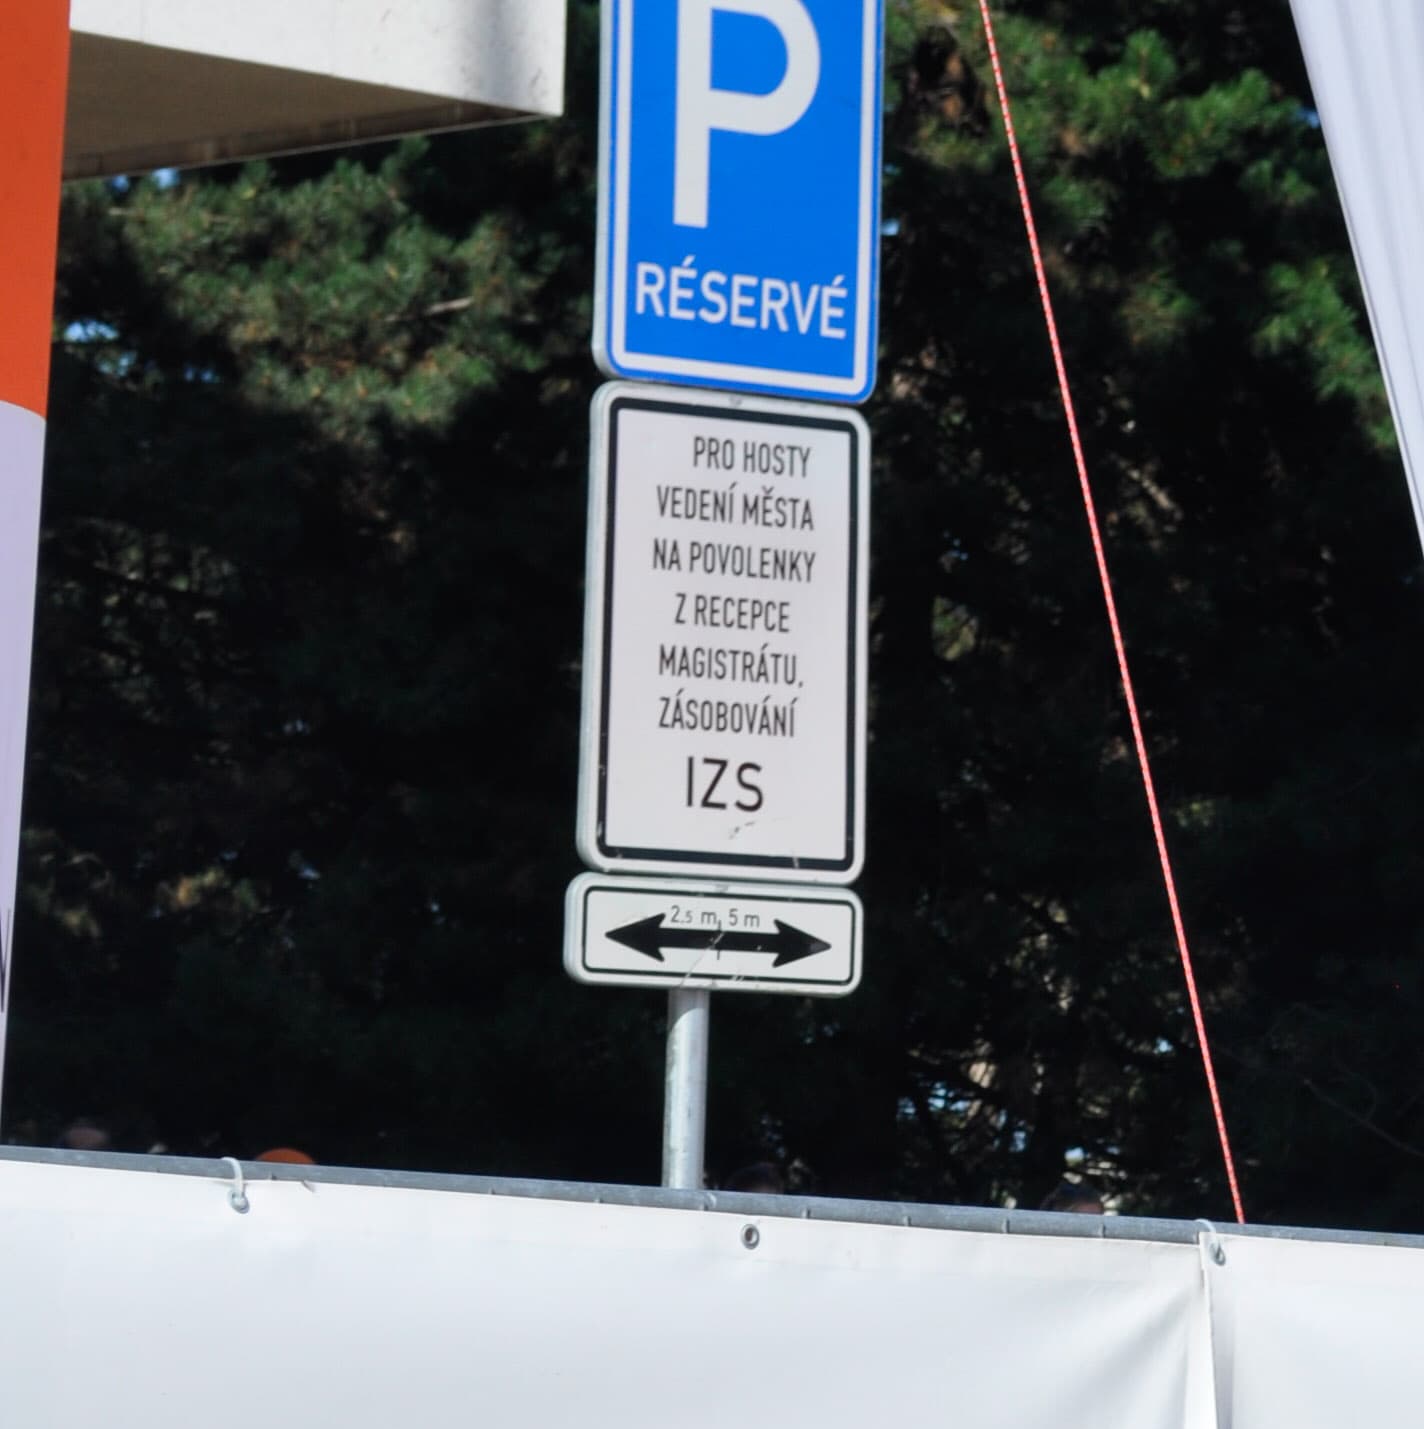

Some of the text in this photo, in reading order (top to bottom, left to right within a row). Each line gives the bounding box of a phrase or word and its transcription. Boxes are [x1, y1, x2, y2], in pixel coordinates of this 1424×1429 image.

[673, 0, 821, 228] P
[635, 255, 848, 339] RÉSERVÉ
[693, 436, 811, 478] PRO HOSTY
[656, 482, 814, 531] VEDENÍ MĚSTA
[653, 538, 816, 583] NA POVOLENKY
[675, 593, 790, 633] Z RECEPCE
[658, 643, 803, 688] MAGISTRÁTU,
[658, 688, 798, 738] ZÁSOBOVÁNÍ
[686, 756, 764, 812] IZS
[729, 908, 738, 927] 5
